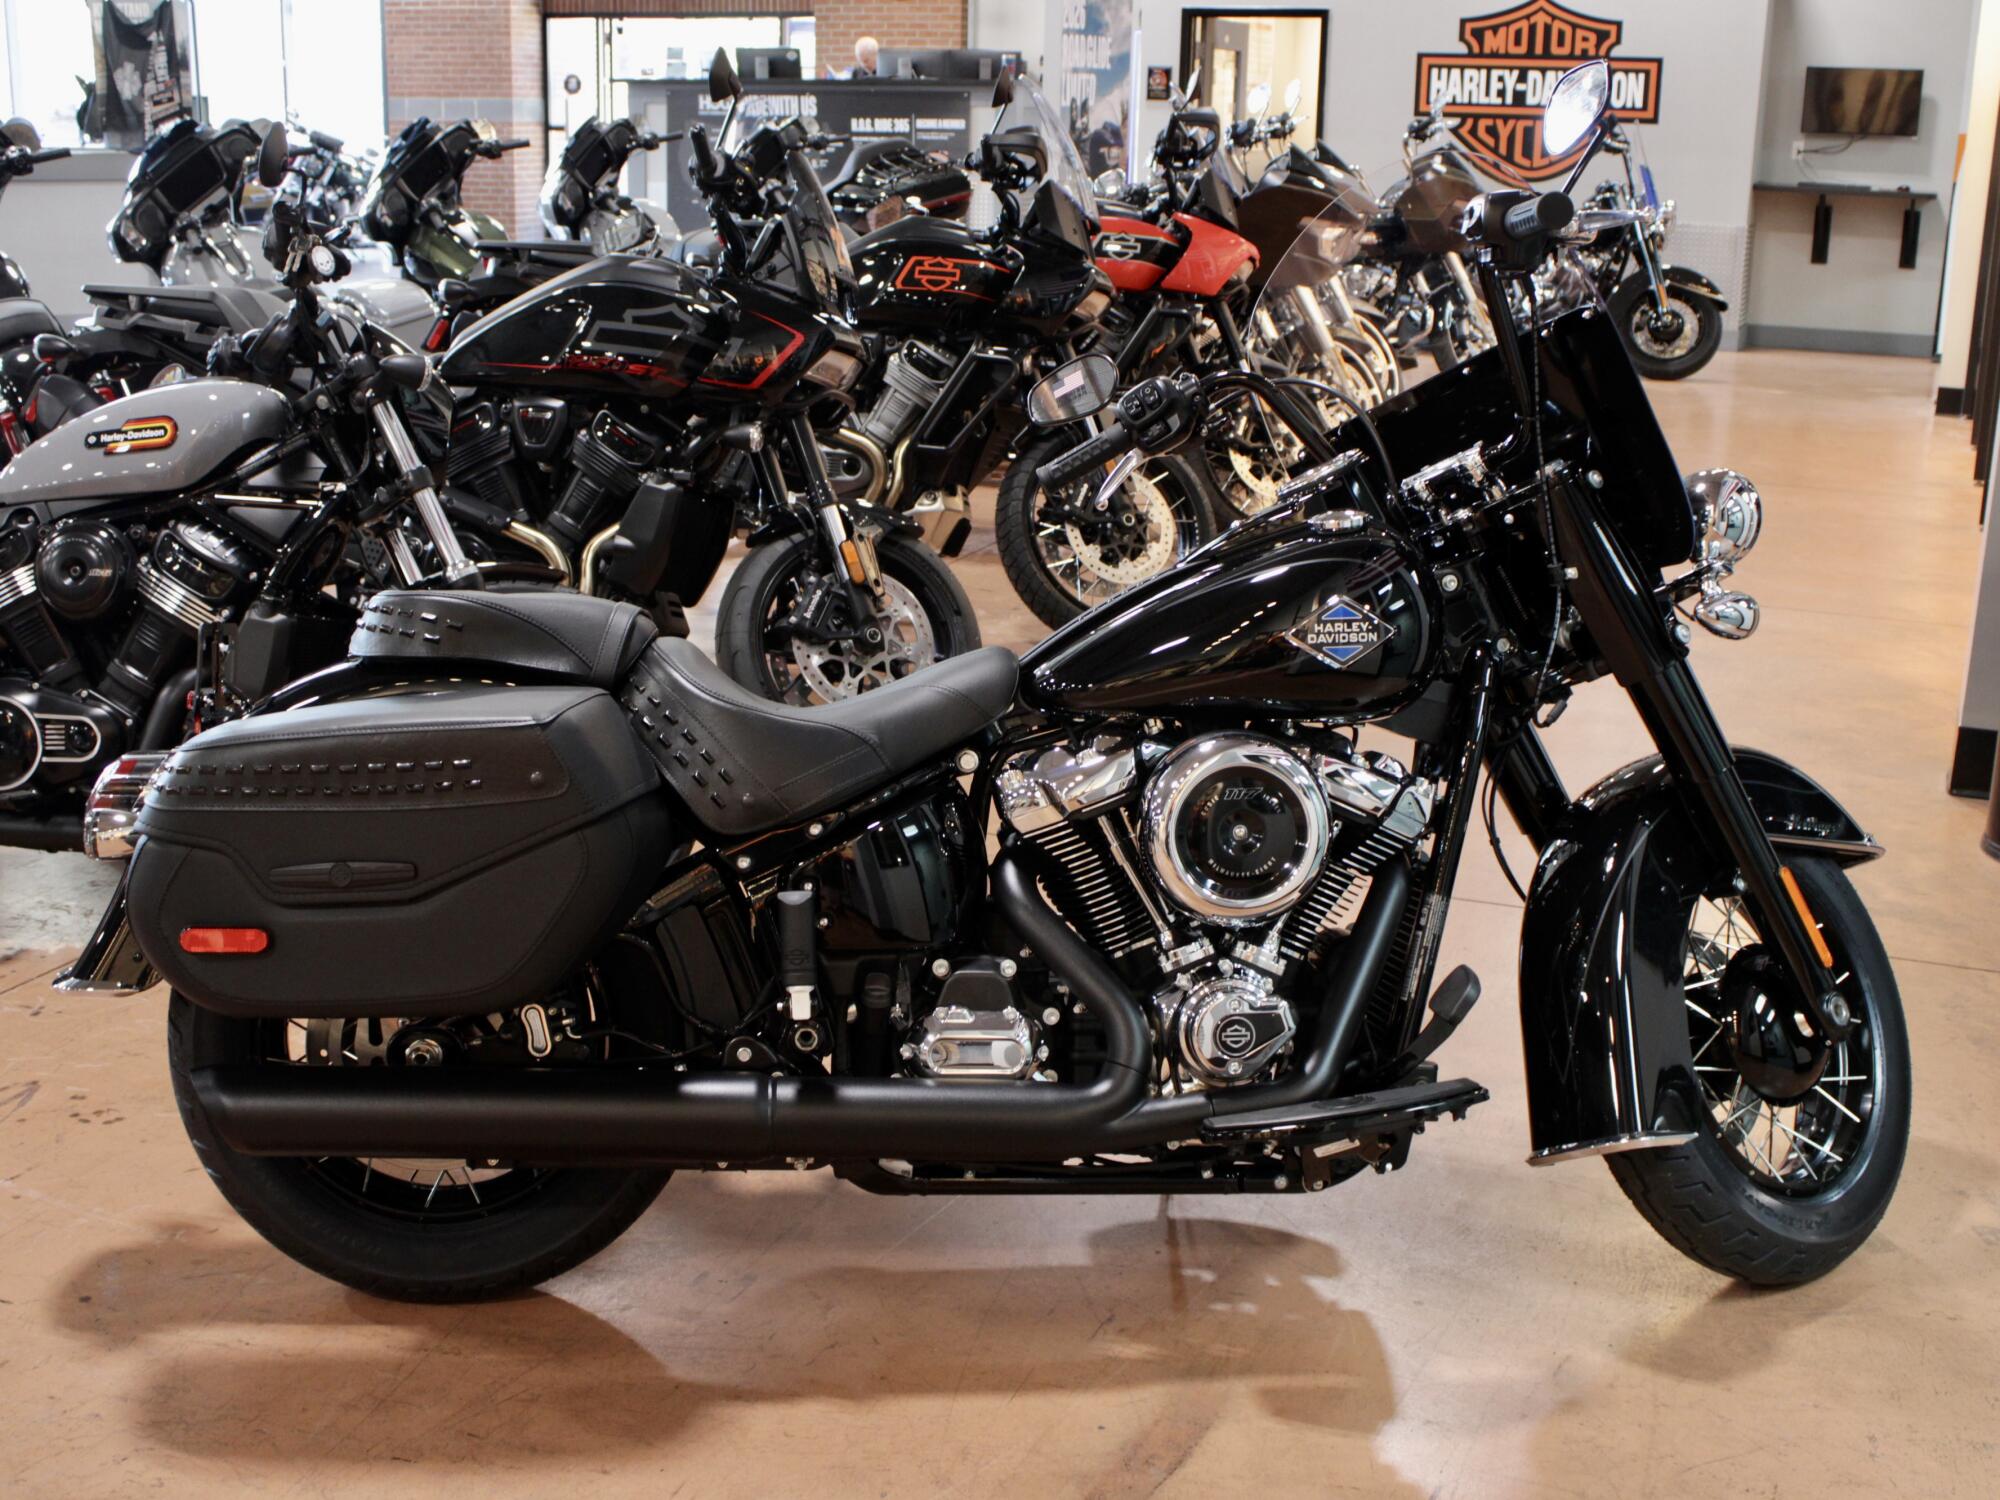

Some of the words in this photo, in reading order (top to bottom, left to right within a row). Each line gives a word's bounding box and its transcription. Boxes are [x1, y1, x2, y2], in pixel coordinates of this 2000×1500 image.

[1483, 16, 1597, 56] MOTOR
[1429, 67, 1645, 109] HARLEY-DAON
[800, 94, 818, 116] US
[100, 428, 165, 443] Harley-Davidson
[1307, 632, 1378, 644] DAVIDSON
[1207, 856, 1276, 878] MILWAUKEE-EIGHT
